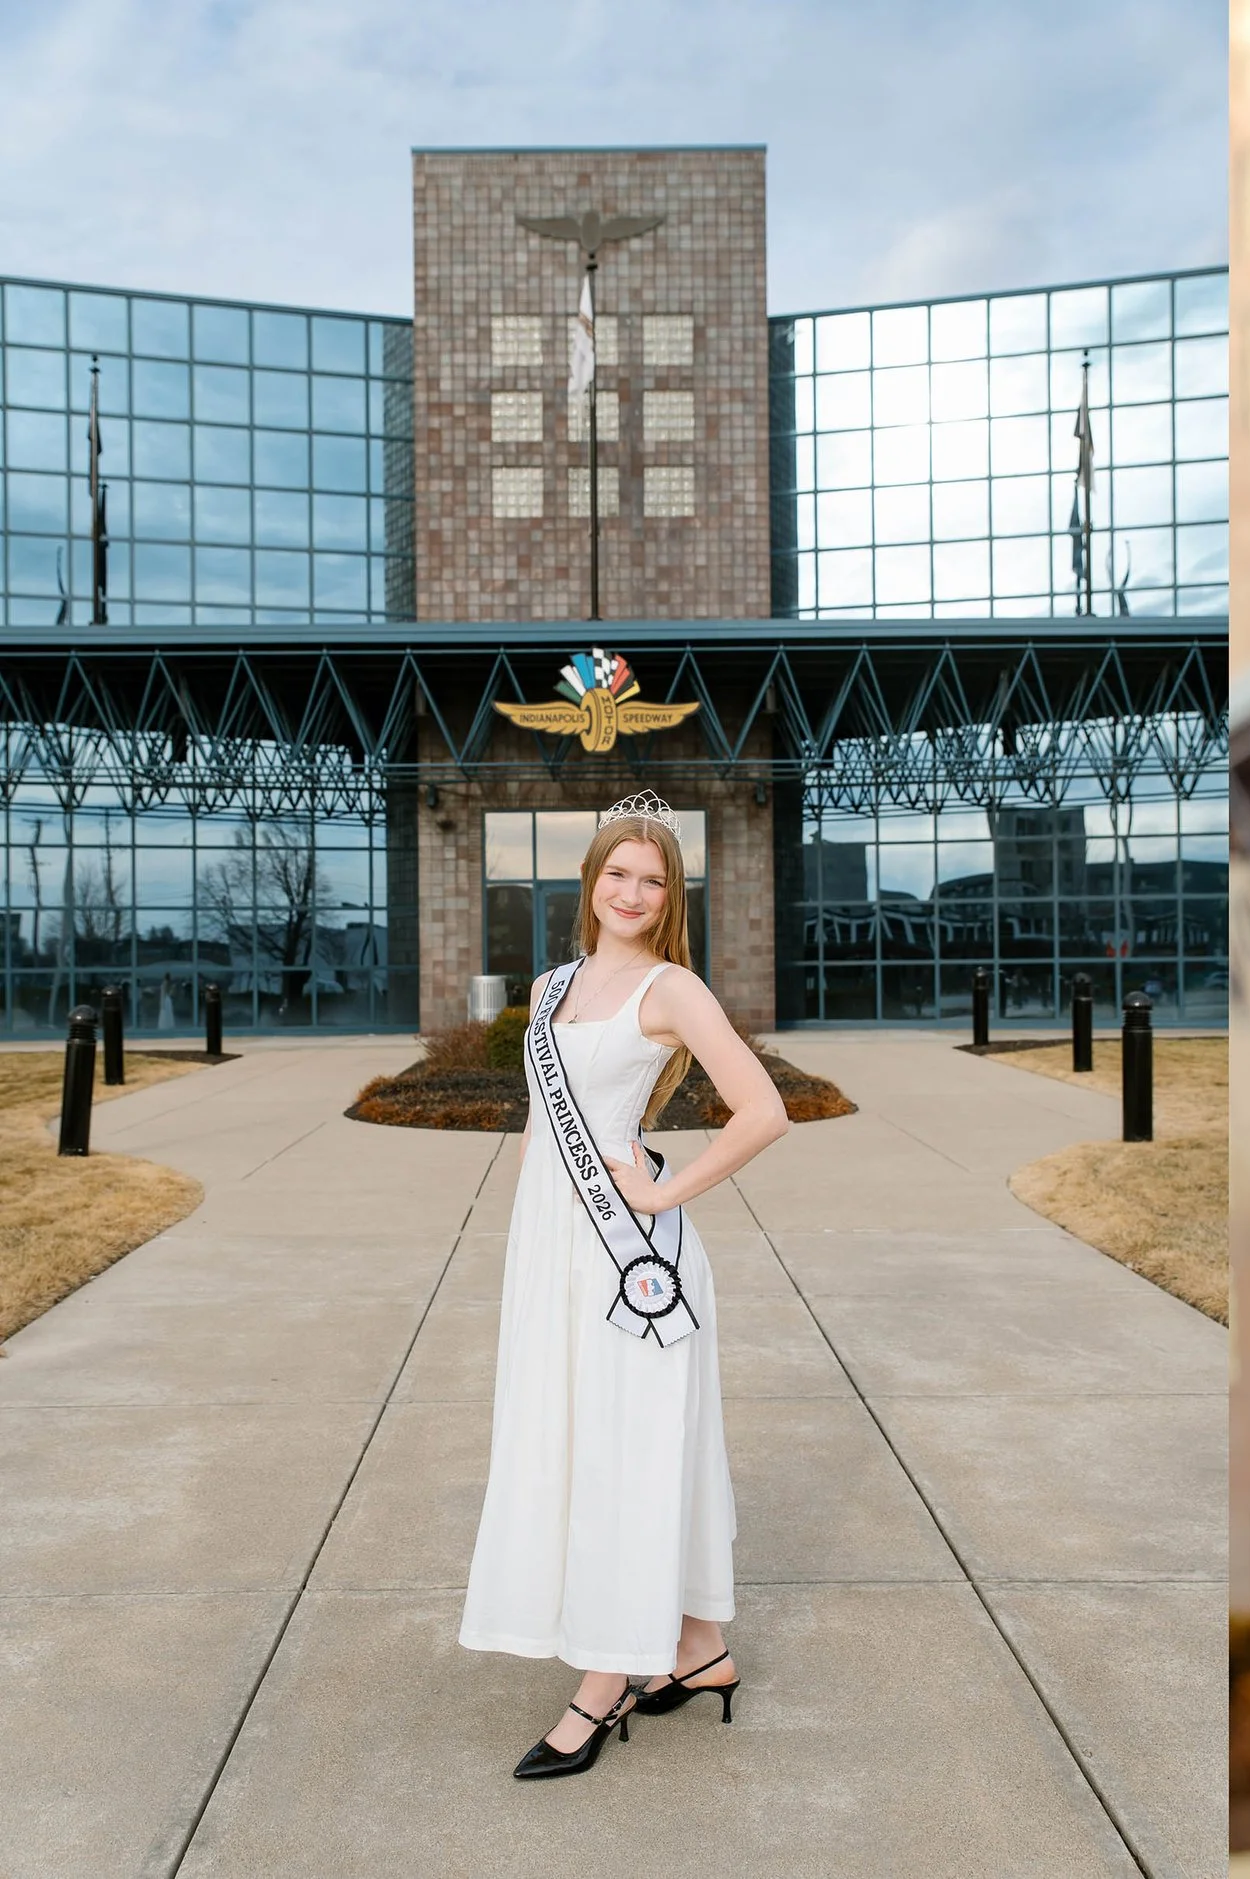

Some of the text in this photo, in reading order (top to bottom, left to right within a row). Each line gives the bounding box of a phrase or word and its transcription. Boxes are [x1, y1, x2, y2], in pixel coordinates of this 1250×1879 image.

[519, 713, 585, 724] INDIANAPOLIS
[601, 696, 611, 746] MOTOR
[622, 713, 673, 724] SPEEDWAY
[533, 980, 616, 1221] 500 FESTIVAL PRINCESS 2026
